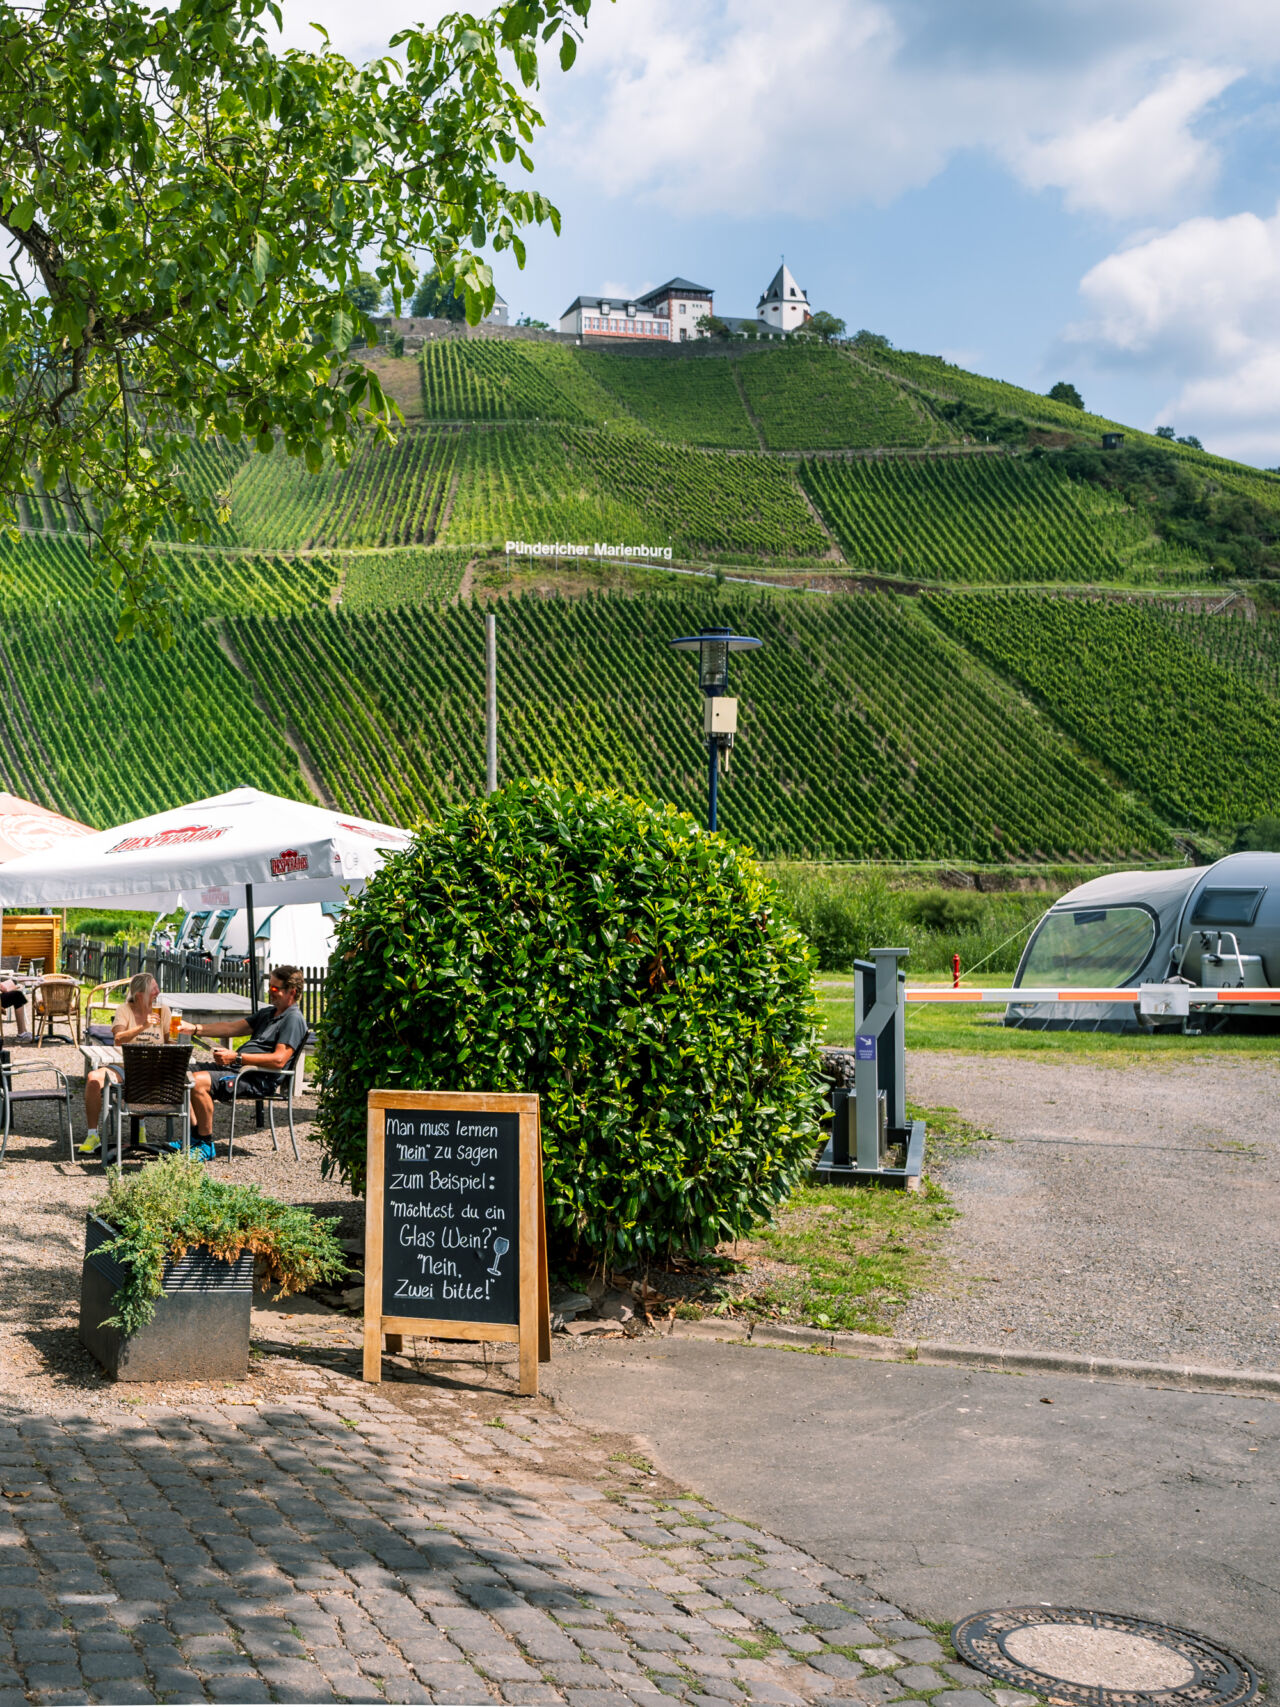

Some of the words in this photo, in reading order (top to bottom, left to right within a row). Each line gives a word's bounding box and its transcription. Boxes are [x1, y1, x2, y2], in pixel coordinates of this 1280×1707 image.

[505, 541, 590, 556] Pündericher
[594, 542, 672, 560] Marienburg
[386, 1118, 414, 1136] Man
[420, 1122, 450, 1136] muss
[456, 1120, 498, 1138] lernen
[434, 1145, 452, 1159] zu
[461, 1204, 480, 1219] du
[485, 1205, 505, 1220] ein
[400, 1223, 435, 1248] Glas
[393, 1279, 434, 1298] Zwei
